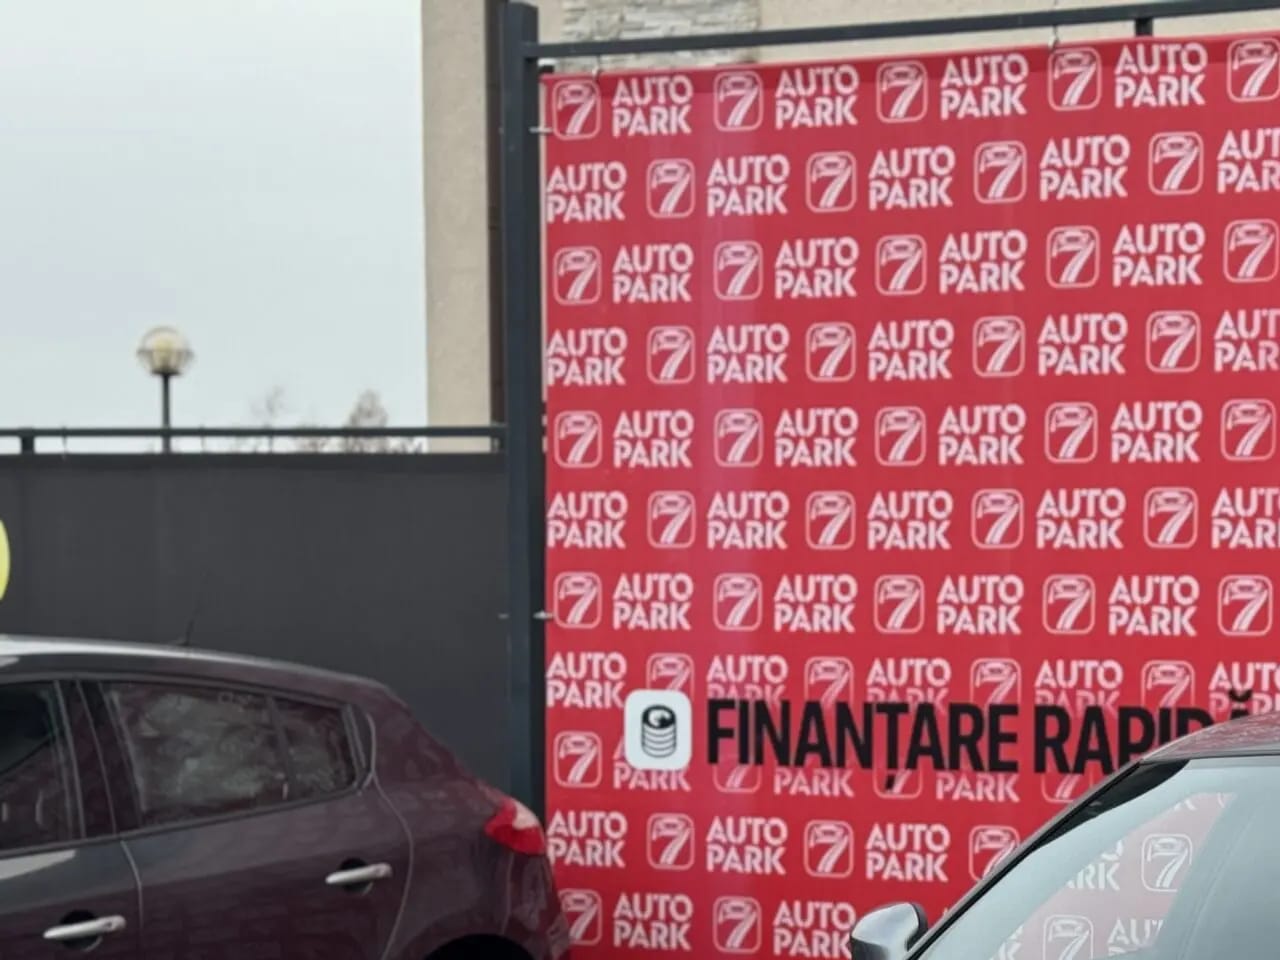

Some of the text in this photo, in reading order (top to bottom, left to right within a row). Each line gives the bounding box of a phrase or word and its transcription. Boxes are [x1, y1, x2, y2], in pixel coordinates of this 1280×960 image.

[939, 52, 1028, 88] AUTO
[1114, 42, 1207, 76] AUTO
[612, 75, 693, 107] AUTO
[774, 64, 859, 98] AUTO
[1115, 74, 1205, 108] PARK
[775, 94, 858, 130] PARK
[940, 83, 1027, 120] PARK
[612, 104, 692, 138] PARK
[868, 145, 955, 180] AUTO
[1040, 134, 1130, 170] AUTO
[546, 161, 627, 194] AUTO
[706, 154, 790, 187] AUTO
[1040, 166, 1128, 201] PARK
[546, 190, 625, 225] PARK
[707, 183, 788, 218] PARK
[869, 176, 953, 211] PARK
[775, 236, 859, 269] AUTO
[939, 229, 1028, 263] AUTO
[1112, 222, 1205, 254] AUTO
[612, 243, 694, 274] AUTO
[1113, 254, 1202, 287] PARK
[613, 272, 691, 303] PARK
[775, 266, 856, 299] PARK
[939, 259, 1025, 294] PARK
[546, 323, 627, 358] AUTO
[706, 323, 790, 354] AUTO
[868, 318, 954, 352] AUTO
[1038, 312, 1128, 345] AUTO
[546, 356, 625, 388] PARK
[707, 352, 787, 384] PARK
[868, 348, 952, 381] PARK
[1038, 343, 1125, 376] PARK
[613, 409, 694, 439] AUTO
[775, 407, 858, 438] AUTO
[938, 404, 1026, 436] AUTO
[1111, 400, 1203, 431] AUTO
[614, 438, 692, 468] PARK
[775, 436, 857, 467] PARK
[939, 434, 1024, 465] PARK
[1111, 431, 1200, 463] PARK
[547, 491, 628, 519] AUTO
[707, 491, 789, 519] AUTO
[867, 490, 953, 521] AUTO
[1036, 488, 1126, 519] AUTO
[547, 519, 625, 549] PARK
[707, 519, 787, 549] PARK
[868, 519, 950, 550] PARK
[1037, 517, 1123, 549] PARK
[613, 572, 694, 602] AUTO
[774, 574, 858, 602] AUTO
[937, 575, 1024, 605] AUTO
[1109, 575, 1199, 606] AUTO
[613, 601, 691, 630] PARK
[774, 602, 855, 632] PARK
[937, 604, 1021, 635] PARK
[1109, 605, 1197, 636] PARK
[547, 652, 627, 681] AUTO
[706, 654, 789, 684] AUTO
[867, 657, 952, 689] AUTO
[1034, 659, 1123, 691] AUTO
[547, 680, 625, 708] PARK
[707, 699, 1019, 791] FINANȚARE
[613, 763, 692, 792] PARK
[774, 767, 855, 799] PARK
[936, 771, 1020, 804] PARK
[547, 811, 627, 839] AUTO
[706, 816, 787, 846] AUTO
[866, 823, 950, 852] AUTO
[547, 836, 624, 867] PARK
[707, 844, 785, 874] PARK
[866, 851, 948, 882] PARK
[615, 894, 692, 922] AUTO
[774, 901, 857, 931] AUTO
[615, 920, 689, 949] PARK
[774, 928, 855, 960] PARK
